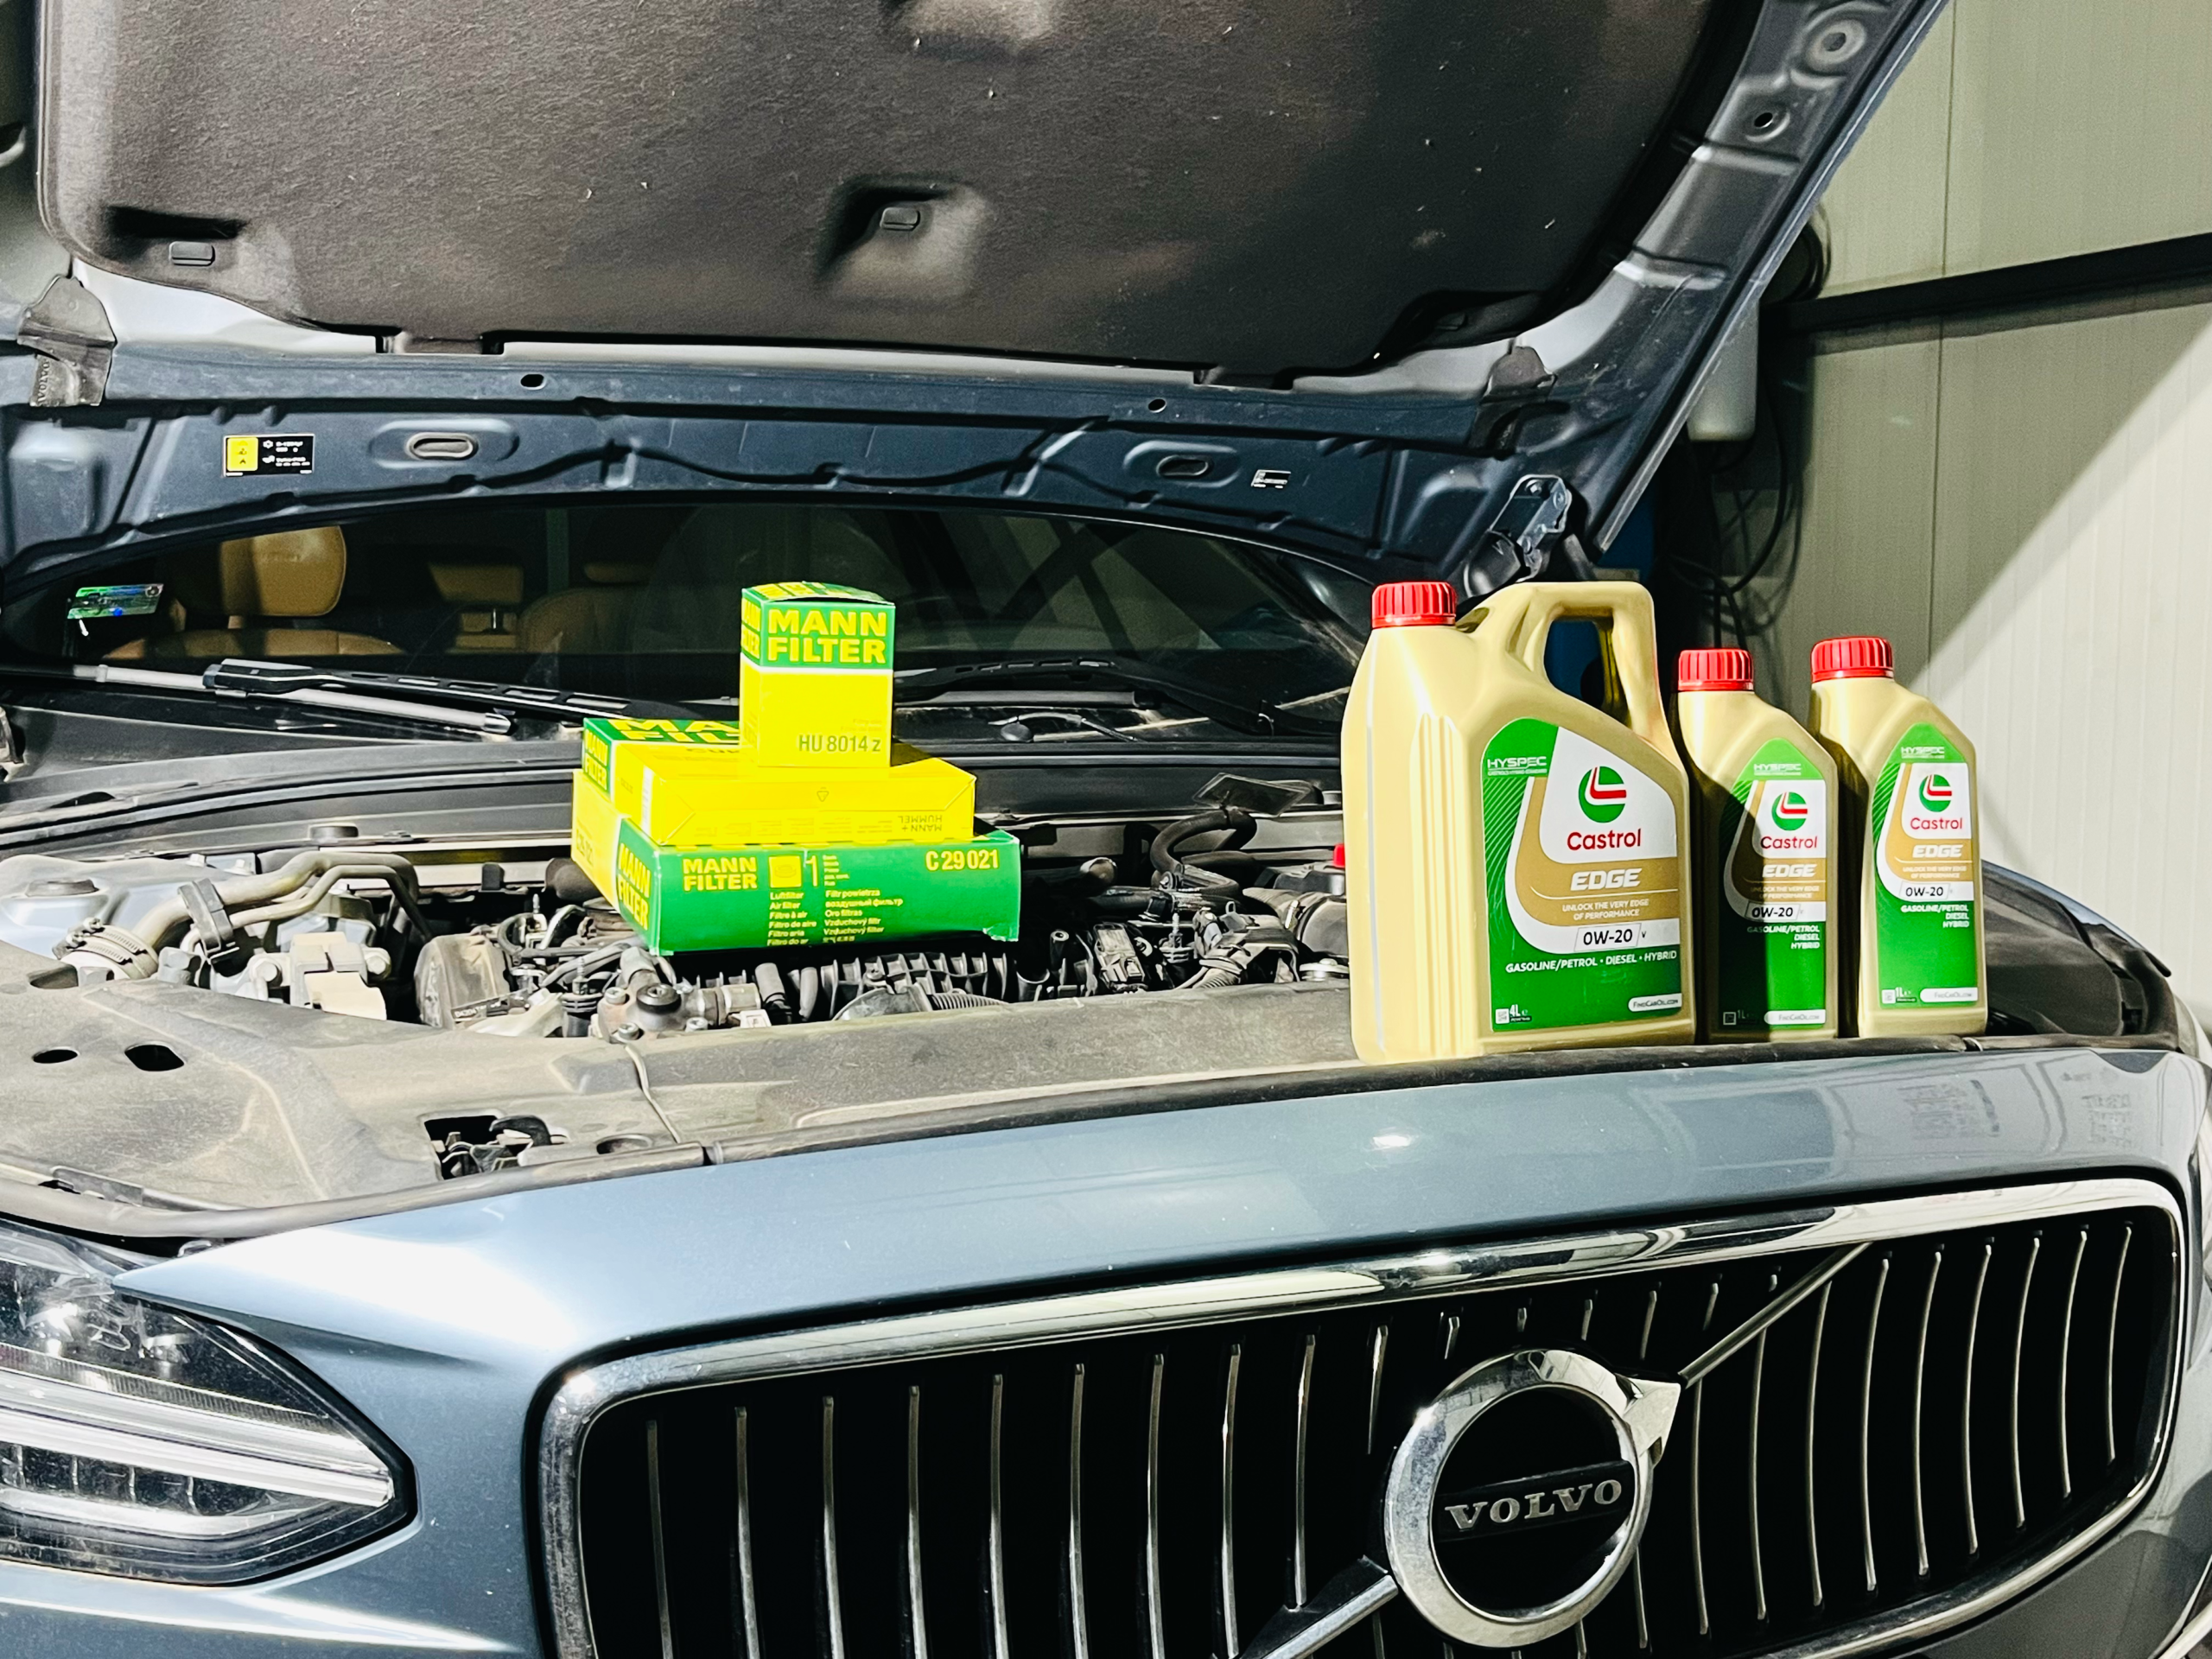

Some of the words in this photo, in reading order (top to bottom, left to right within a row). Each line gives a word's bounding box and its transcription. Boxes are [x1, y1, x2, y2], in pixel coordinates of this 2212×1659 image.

[768, 609, 887, 637] MANN
[767, 637, 887, 664] FILTER
[798, 734, 823, 752] HU
[1487, 756, 1547, 769] HYSPEC
[1910, 817, 1962, 830] Castrol
[1567, 828, 1642, 851] Castrol
[1760, 836, 1817, 849] Castrol
[1912, 844, 1964, 858] EDGE
[618, 842, 652, 899] MANN
[683, 857, 757, 874] MANN
[1762, 864, 1817, 878] EDGE
[683, 874, 758, 891] FILTER
[1570, 868, 1643, 891] EDGE
[1905, 887, 1943, 897] 0W-20
[617, 874, 649, 931] FILTER
[1562, 902, 1594, 912] UNLOCK
[1630, 899, 1649, 907] EDGE
[1900, 905, 1969, 913] GASOLINE/PETROL
[1585, 909, 1640, 920] PERFORMANCE
[1751, 907, 1794, 918] 0W-20
[1583, 929, 1633, 945] 0W-20
[1746, 925, 1820, 934] GASOLINE/PETROL
[1505, 957, 1598, 973] GASOLINE/PETROL
[1605, 954, 1637, 966] DIESEL
[1643, 950, 1677, 963] HYBRID
[1444, 1479, 1622, 1529] VOLVO
